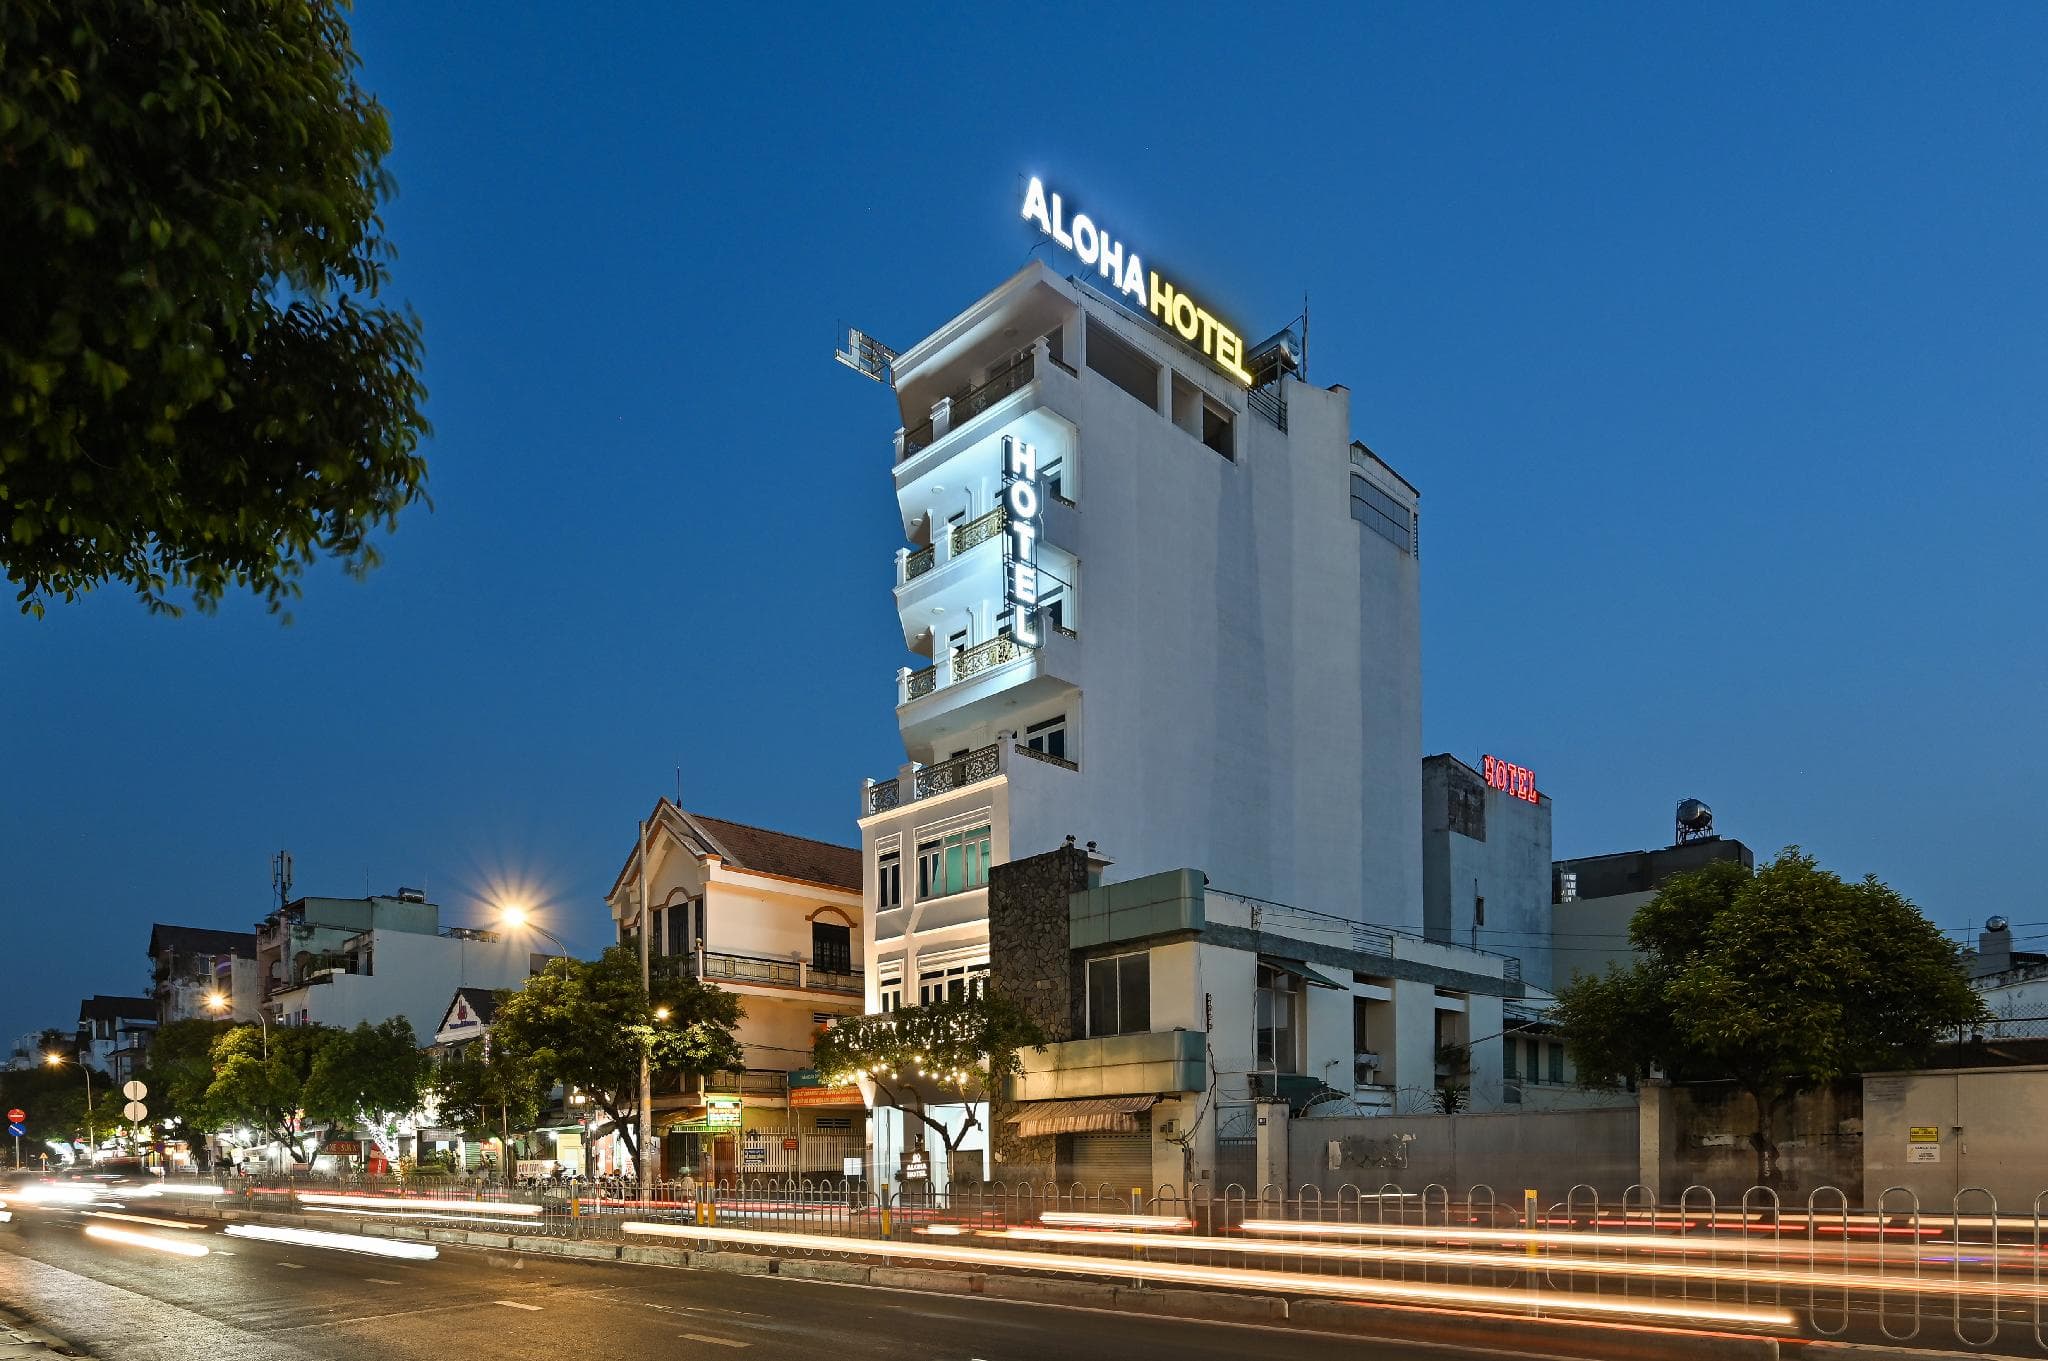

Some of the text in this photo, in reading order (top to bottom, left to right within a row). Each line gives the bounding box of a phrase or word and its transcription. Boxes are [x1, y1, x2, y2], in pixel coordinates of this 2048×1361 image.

[1021, 176, 1254, 386] ALOHA HOTEL
[1009, 435, 1037, 645] HOTEL
[1483, 755, 1538, 804] HOTEL
[906, 1170, 928, 1178] HOTEL
